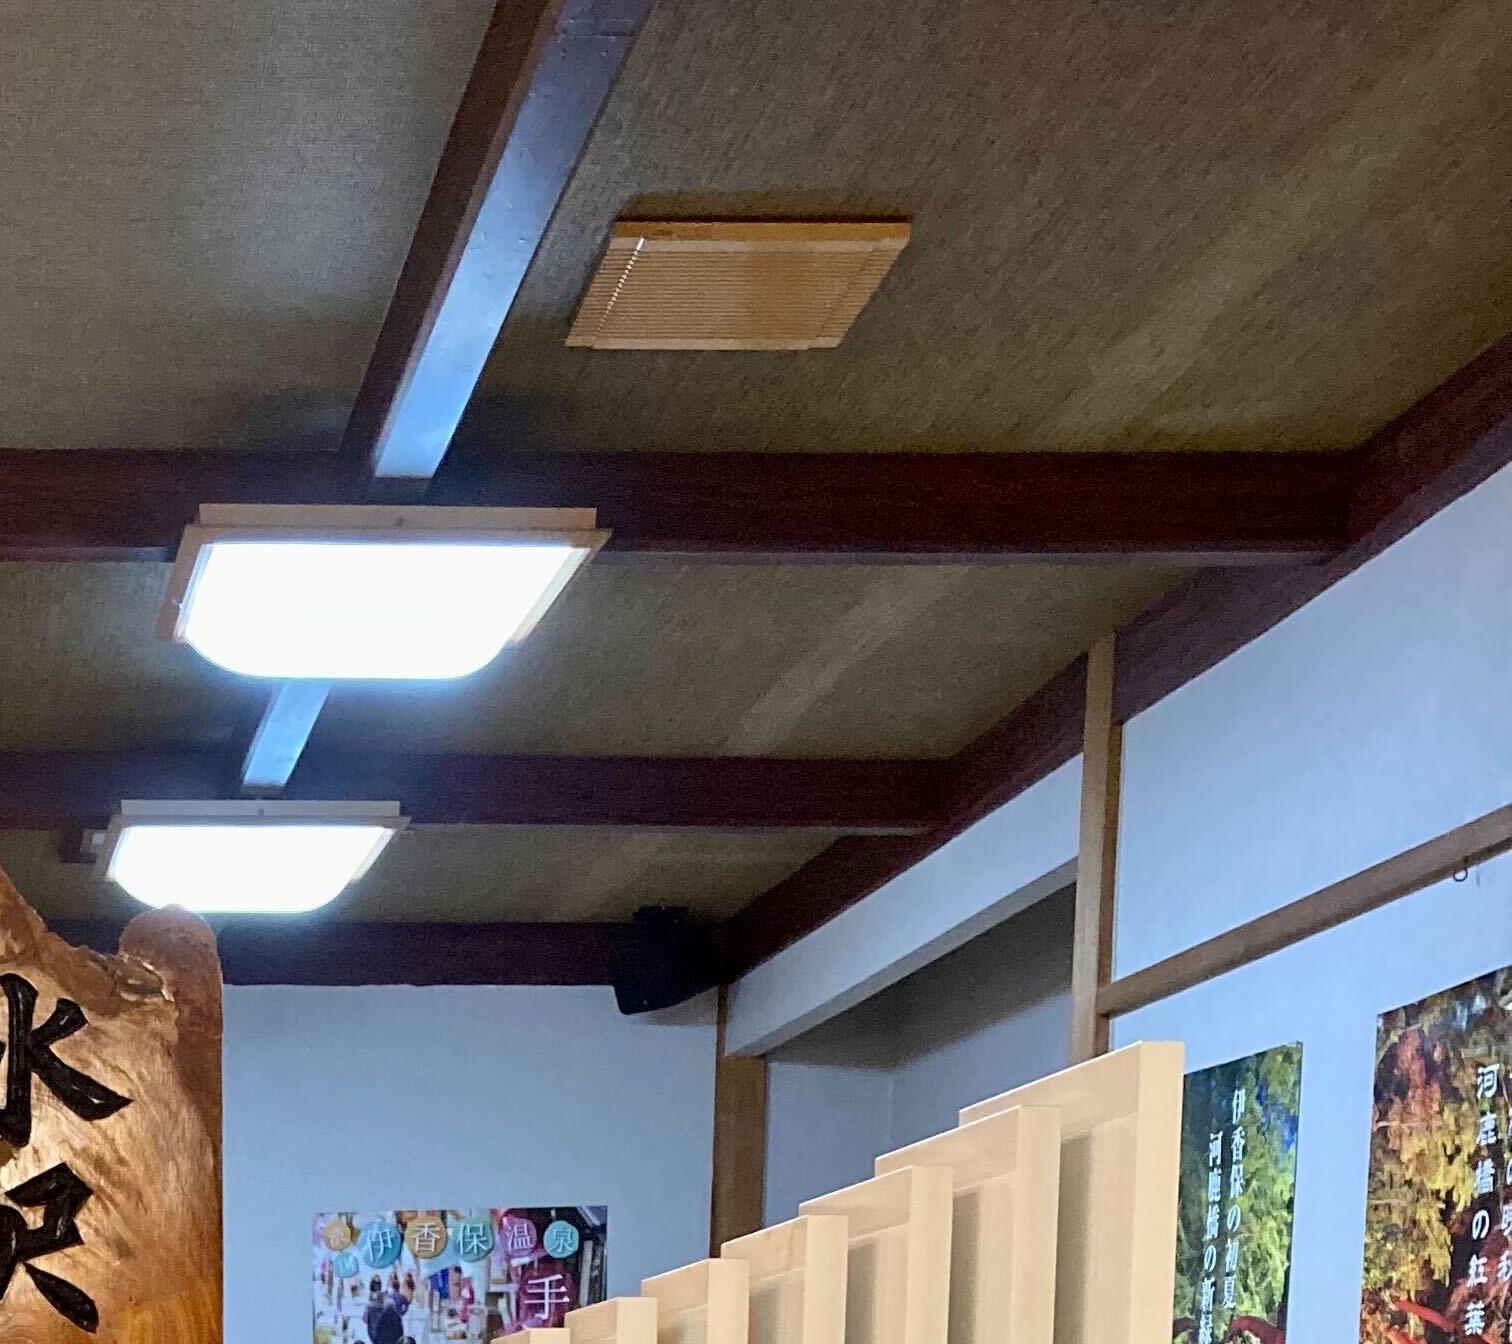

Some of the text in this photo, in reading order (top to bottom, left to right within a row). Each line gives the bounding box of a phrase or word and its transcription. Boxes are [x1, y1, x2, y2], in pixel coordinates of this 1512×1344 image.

[363, 1219, 575, 1261] 伊香保温泉
